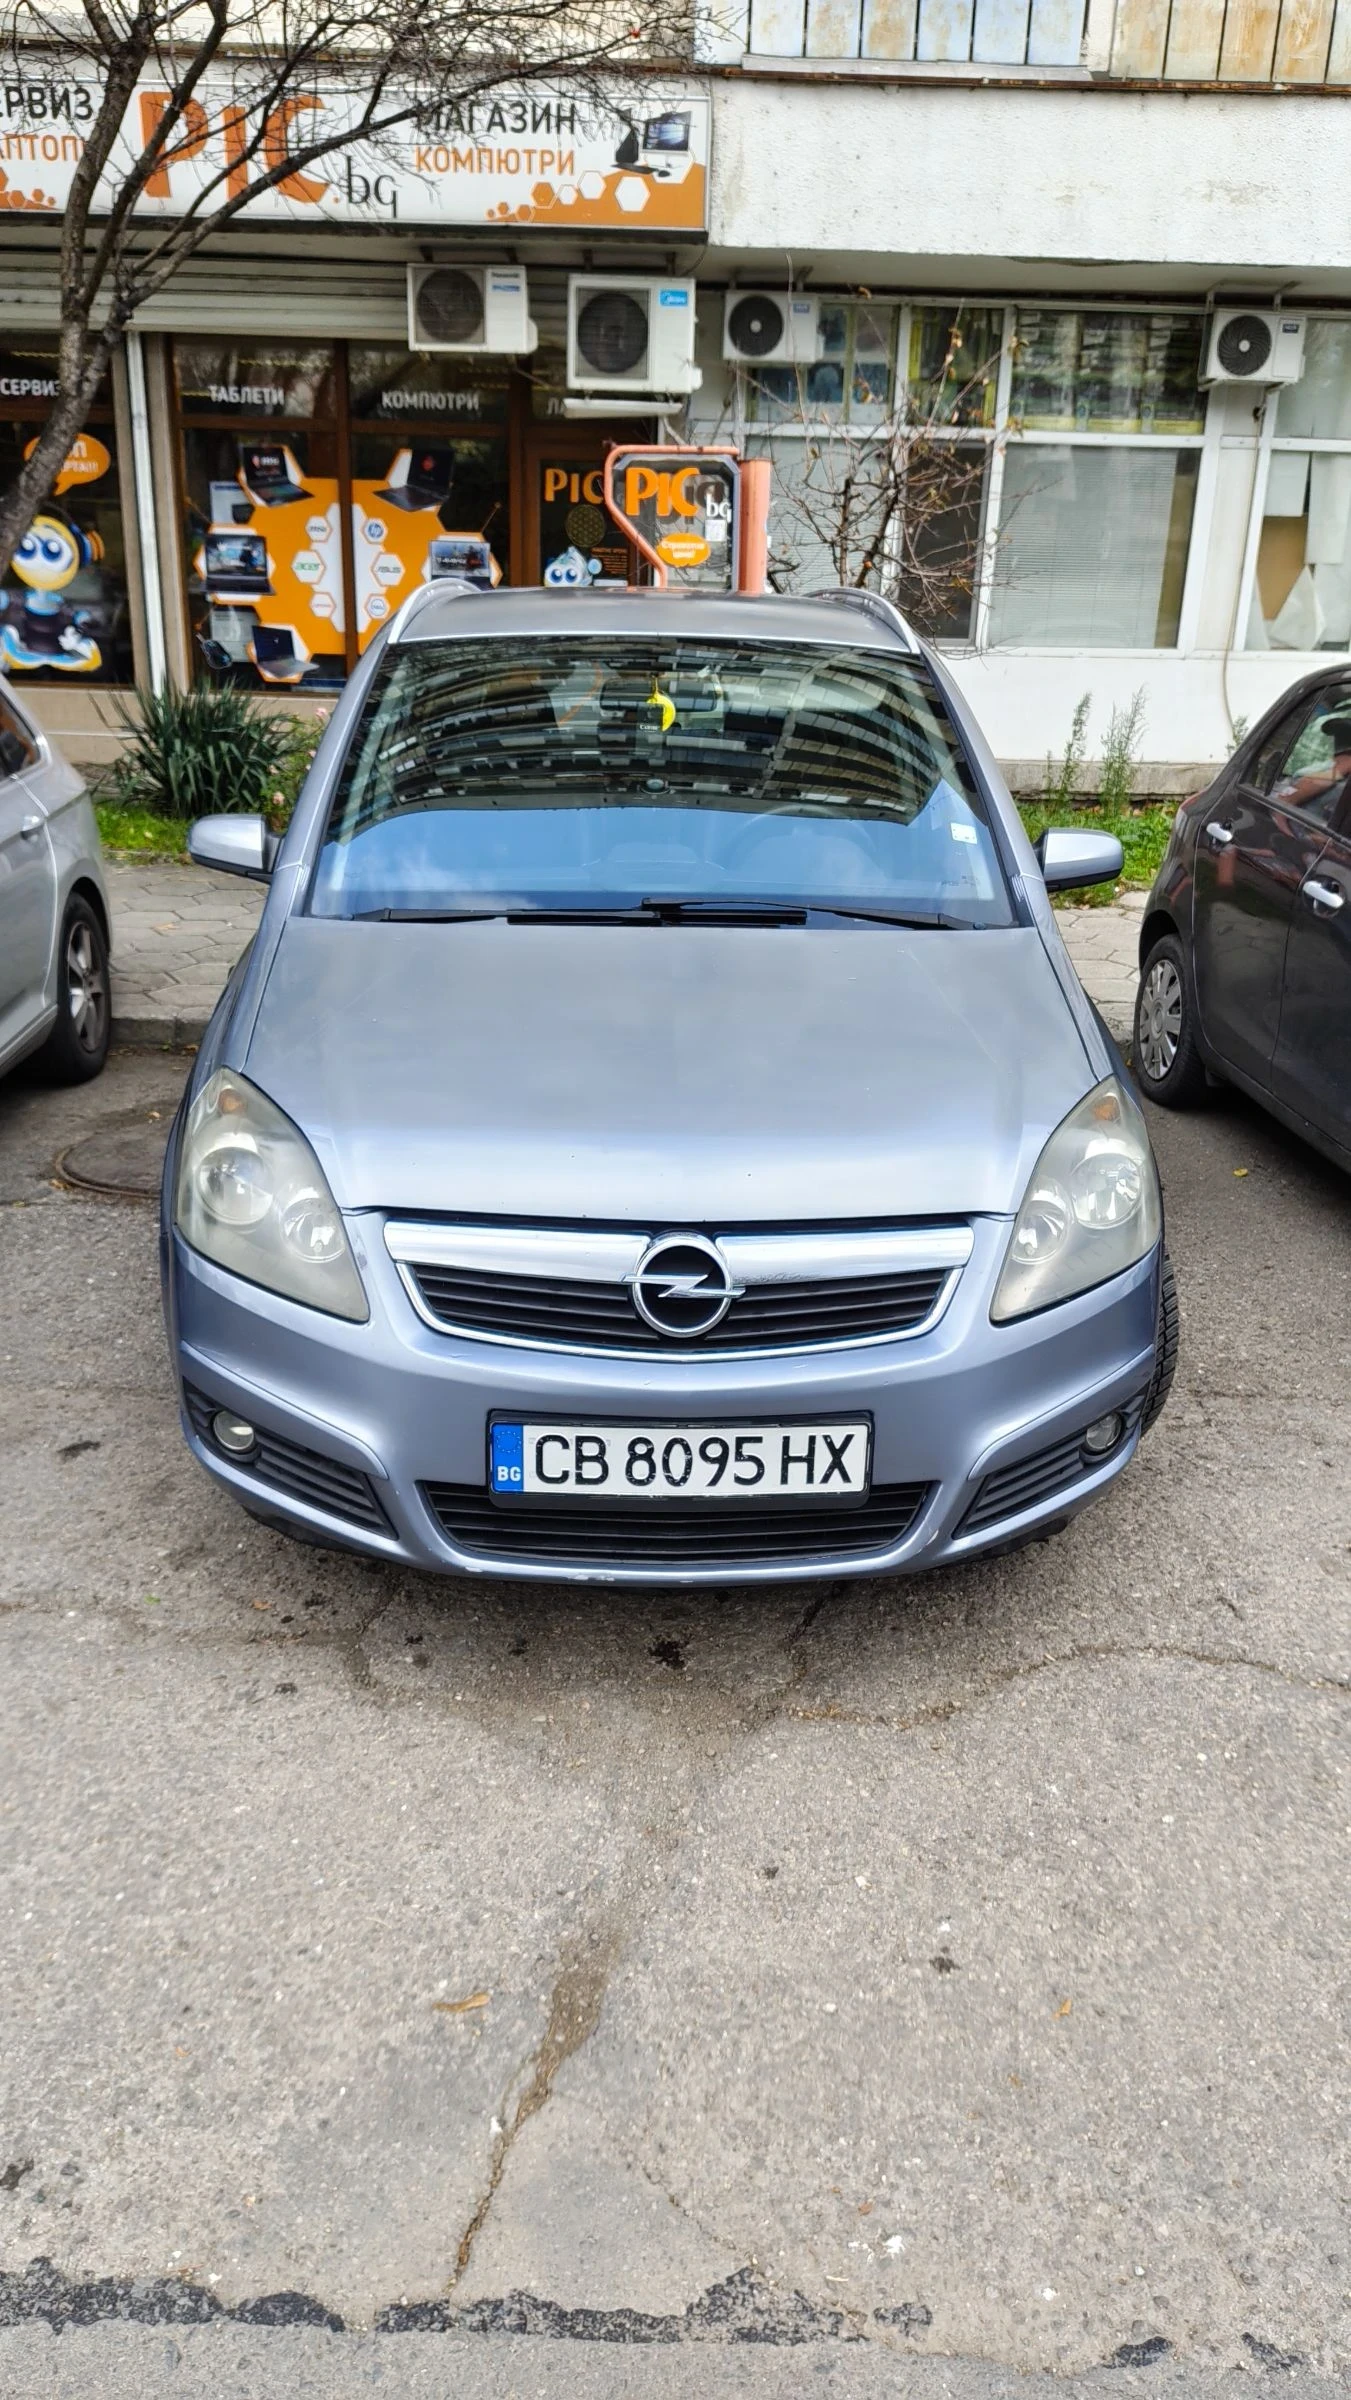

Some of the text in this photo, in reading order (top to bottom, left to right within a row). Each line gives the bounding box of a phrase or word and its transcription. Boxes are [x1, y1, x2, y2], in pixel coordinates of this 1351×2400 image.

[0, 86, 93, 120] РВИЗ
[0, 133, 86, 161] ПТОП
[415, 145, 575, 175] КОМПЮТРИ
[208, 385, 285, 405] ТАБЛЕТИ
[382, 389, 480, 410] КОМПЮТРИ
[545, 467, 604, 504] PIC
[497, 1465, 522, 1482] BG
[535, 1433, 856, 1488] CB 8095 HX
